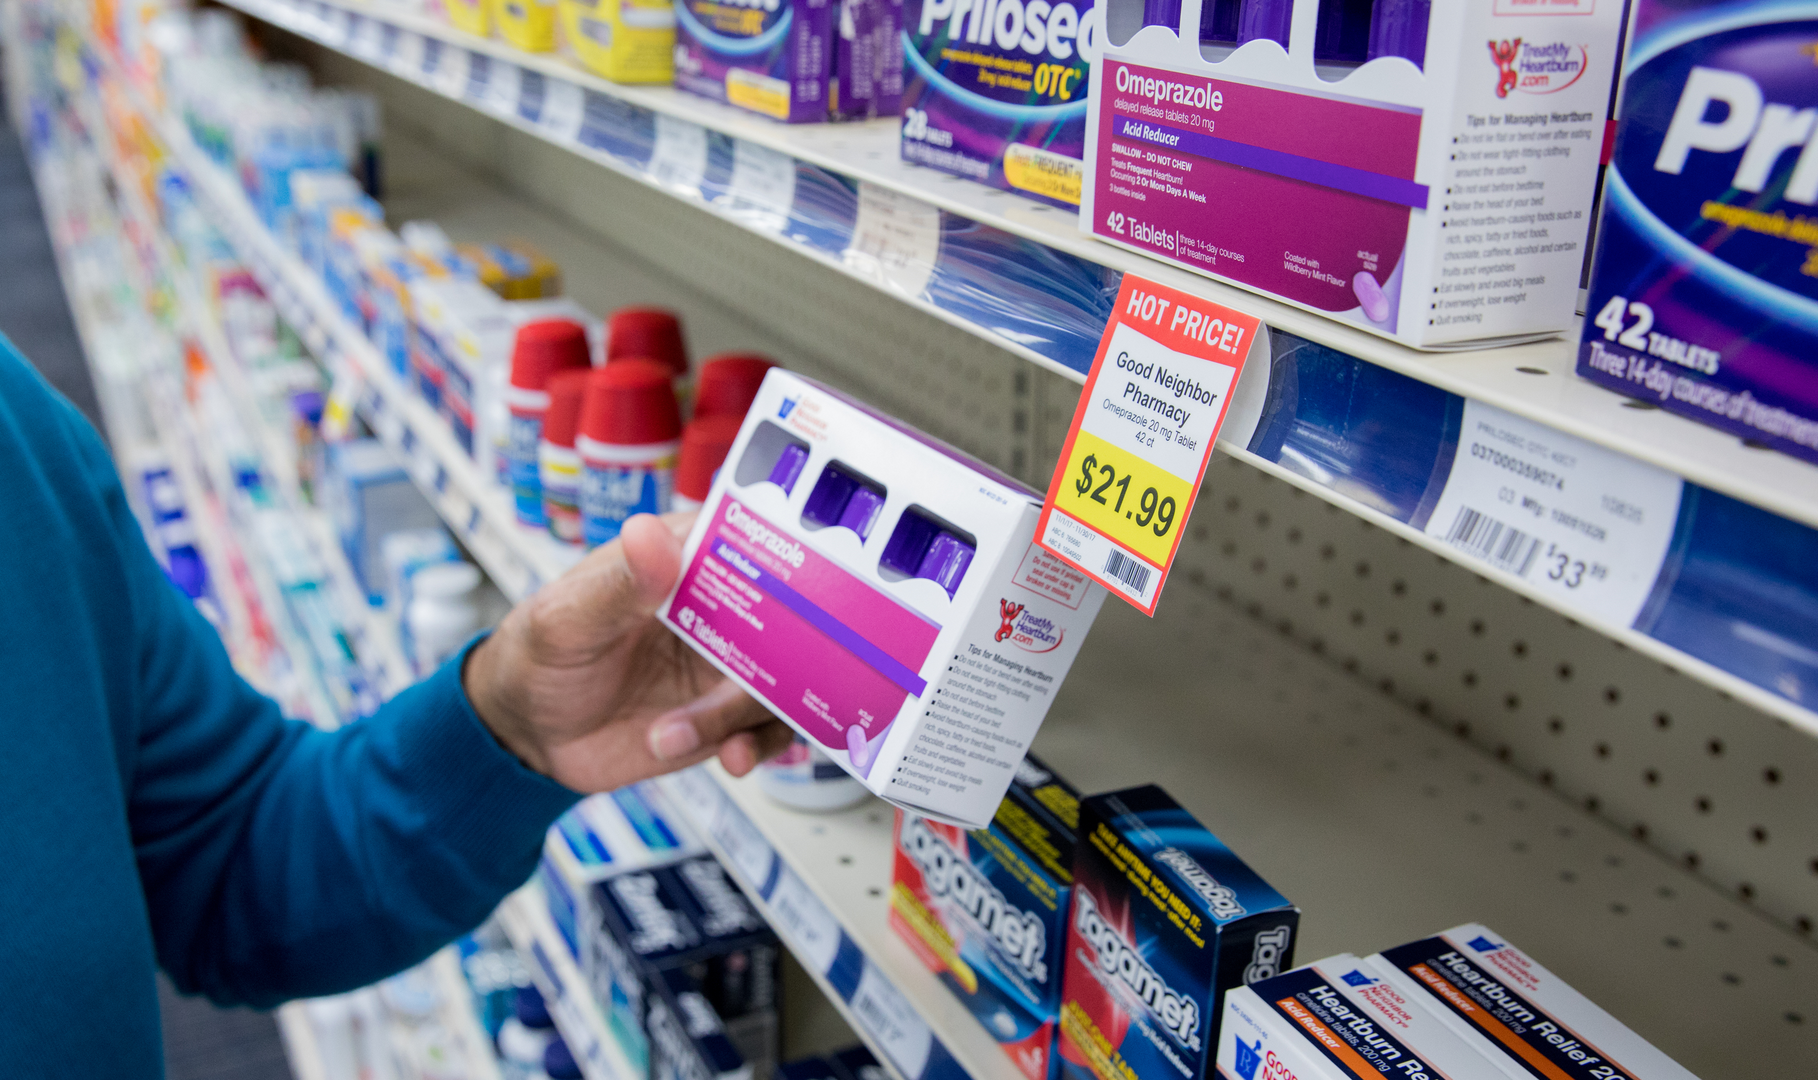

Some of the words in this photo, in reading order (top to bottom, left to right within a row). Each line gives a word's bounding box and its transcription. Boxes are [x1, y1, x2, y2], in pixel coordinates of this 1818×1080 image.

[1520, 59, 1579, 72] Heartburn
[1115, 65, 1223, 111] Omeprazole
[903, 107, 928, 140] 28
[1114, 97, 1138, 113] delayed
[1139, 103, 1163, 117] release
[1165, 108, 1189, 123] tablets
[1190, 114, 1200, 126] 20
[1202, 118, 1214, 131] mg
[1467, 114, 1485, 127] Tips
[1488, 115, 1501, 125] for
[1503, 113, 1548, 127] Managing
[1550, 111, 1592, 122] Heartburn
[1123, 120, 1142, 137] Acid
[1142, 125, 1179, 146] Reducer
[1110, 158, 1126, 169] Treats
[1127, 162, 1152, 177] Frequent
[1111, 143, 1141, 158] SWALLOW
[1146, 151, 1156, 162] DO
[1157, 155, 1170, 166] NOT
[1171, 158, 1192, 172] CHEW
[1109, 183, 1113, 191] 3
[1114, 184, 1129, 196] bottles
[1130, 190, 1145, 201] inside
[1110, 168, 1135, 185] Occurring
[1136, 176, 1140, 184] 2
[1141, 177, 1148, 187] Or
[1149, 180, 1164, 192] More
[1165, 184, 1181, 197] Days
[1182, 189, 1187, 198] A
[1188, 190, 1206, 203] Week
[1106, 209, 1125, 234] 42
[1126, 216, 1174, 250] Tablets
[1179, 234, 1195, 247] three
[1196, 239, 1218, 256] 14-day
[1219, 247, 1244, 263] courses
[1179, 244, 1186, 254] of
[1186, 247, 1216, 265] treatment
[1284, 251, 1305, 265] Coated
[1306, 259, 1319, 269] with
[1283, 260, 1310, 278] Wildberry
[1312, 269, 1326, 281] Mint
[1327, 274, 1345, 287] Flavor
[1126, 289, 1170, 325] HOT
[1169, 305, 1244, 354] PRICE!
[1594, 295, 1654, 352] 42
[1649, 332, 1720, 375] TABLETS
[1116, 350, 1154, 379] Good
[1153, 366, 1217, 406] Neighbor
[1589, 341, 1627, 378] Three
[1626, 355, 1674, 401] 14-day
[1122, 381, 1191, 428] Pharmacy
[1102, 397, 1148, 427] Omeprazole
[1147, 419, 1160, 433] 20
[1158, 427, 1173, 442] mg
[1173, 430, 1197, 451] Tablet
[1134, 430, 1146, 443] 42
[1145, 437, 1155, 448] ct
[1075, 454, 1176, 536] $21.99
[725, 501, 805, 567] Omeprazole
[678, 607, 695, 628] 42
[693, 616, 731, 656] Tablets
[1012, 633, 1034, 647] .com
[1015, 620, 1057, 645] Heartburn
[1022, 610, 1055, 633] TreatMy
[967, 643, 982, 656] Tips
[981, 649, 993, 659] for
[992, 653, 1024, 673] Managing
[1023, 666, 1053, 682] Heartburn
[1155, 849, 1245, 919] Tagamet
[1077, 892, 1195, 1041] Tagamet
[1246, 928, 1288, 983] Tag
[1370, 987, 1412, 1021] NEIGHBOR
[1378, 984, 1405, 1004] GOOD
[1412, 966, 1438, 984] Acid
[1435, 980, 1475, 1013] Reducer
[1281, 1000, 1304, 1020] Acid
[1301, 1015, 1340, 1049] Reducer
[1438, 951, 1535, 1023] Heartburn
[1531, 1021, 1600, 1066] Relief
[1493, 1007, 1512, 1023] 200
[1510, 1021, 1527, 1034] mg
[1297, 993, 1332, 1024] cimetidine
[1331, 1022, 1359, 1047] tablets,
[1358, 1045, 1378, 1060] 200
[1373, 1058, 1390, 1073] mg
[1309, 985, 1401, 1060] Heartburn
[1397, 1058, 1438, 1080] Re
